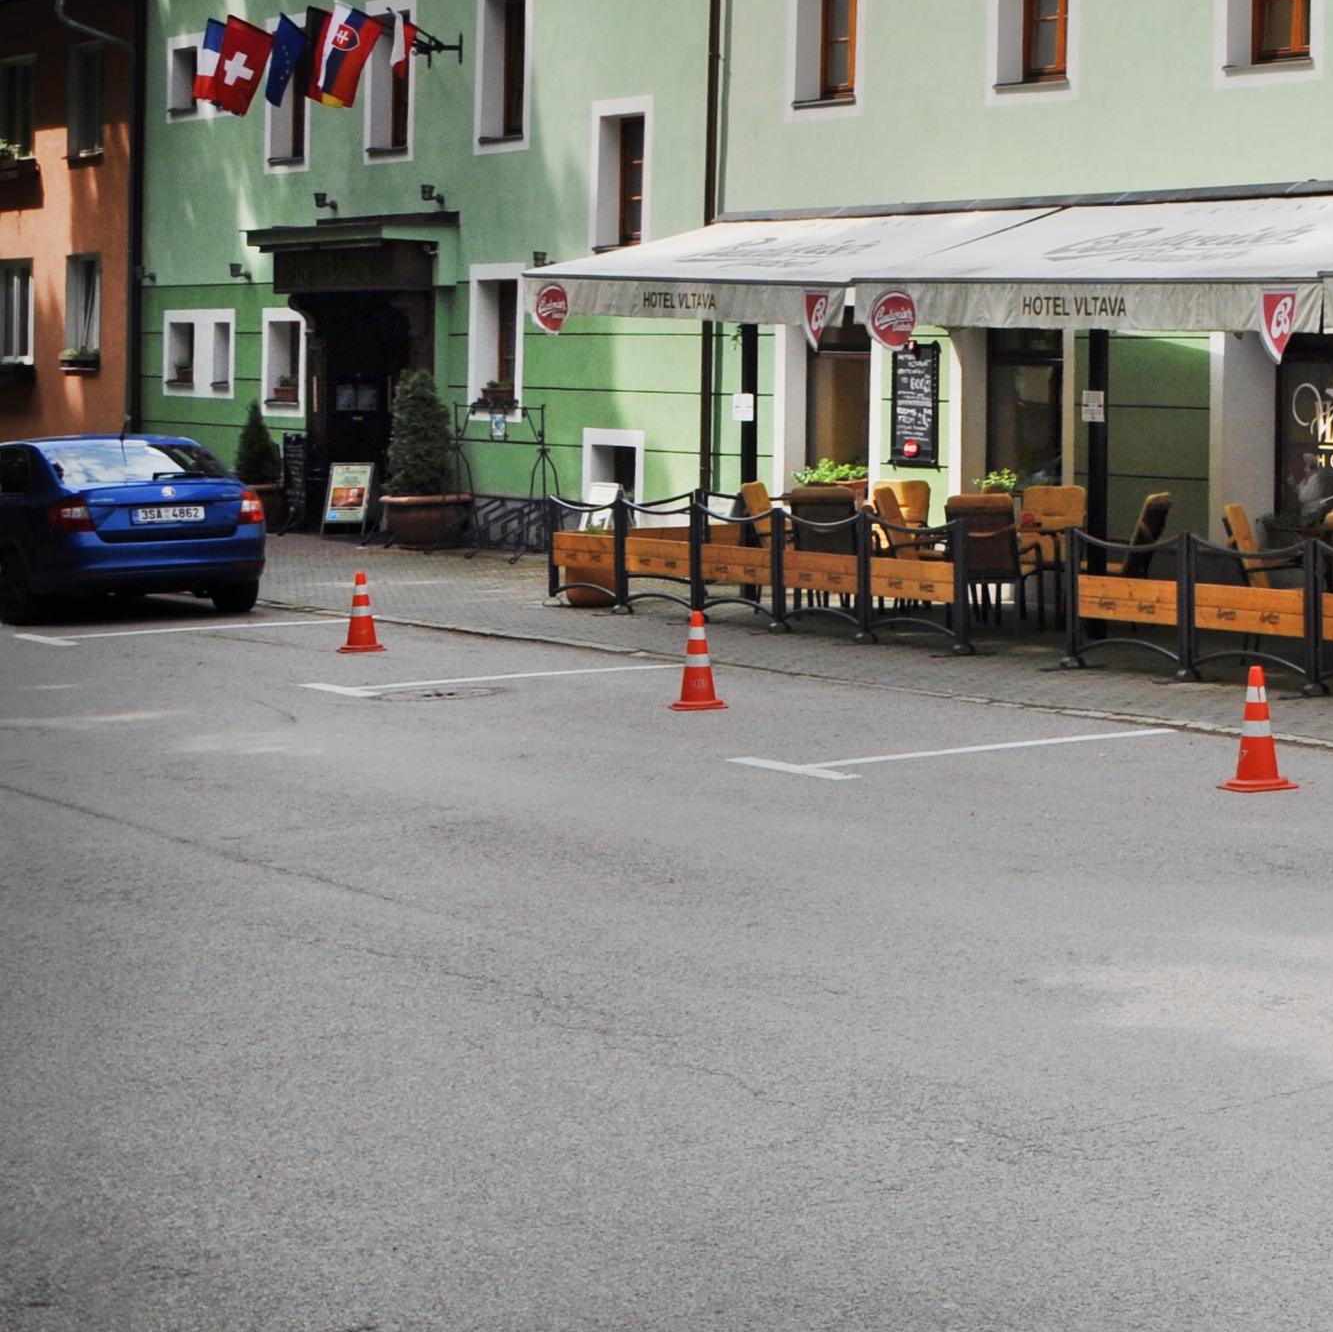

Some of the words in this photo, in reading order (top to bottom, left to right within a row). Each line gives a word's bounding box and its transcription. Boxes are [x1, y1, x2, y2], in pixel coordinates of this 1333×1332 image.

[643, 291, 676, 309] HOTEL
[678, 292, 717, 311] VLTAVA
[1023, 296, 1070, 317] HOTEL
[1074, 296, 1127, 317] VLTAVA
[141, 508, 163, 520] 3SA
[171, 507, 200, 519] 4862
